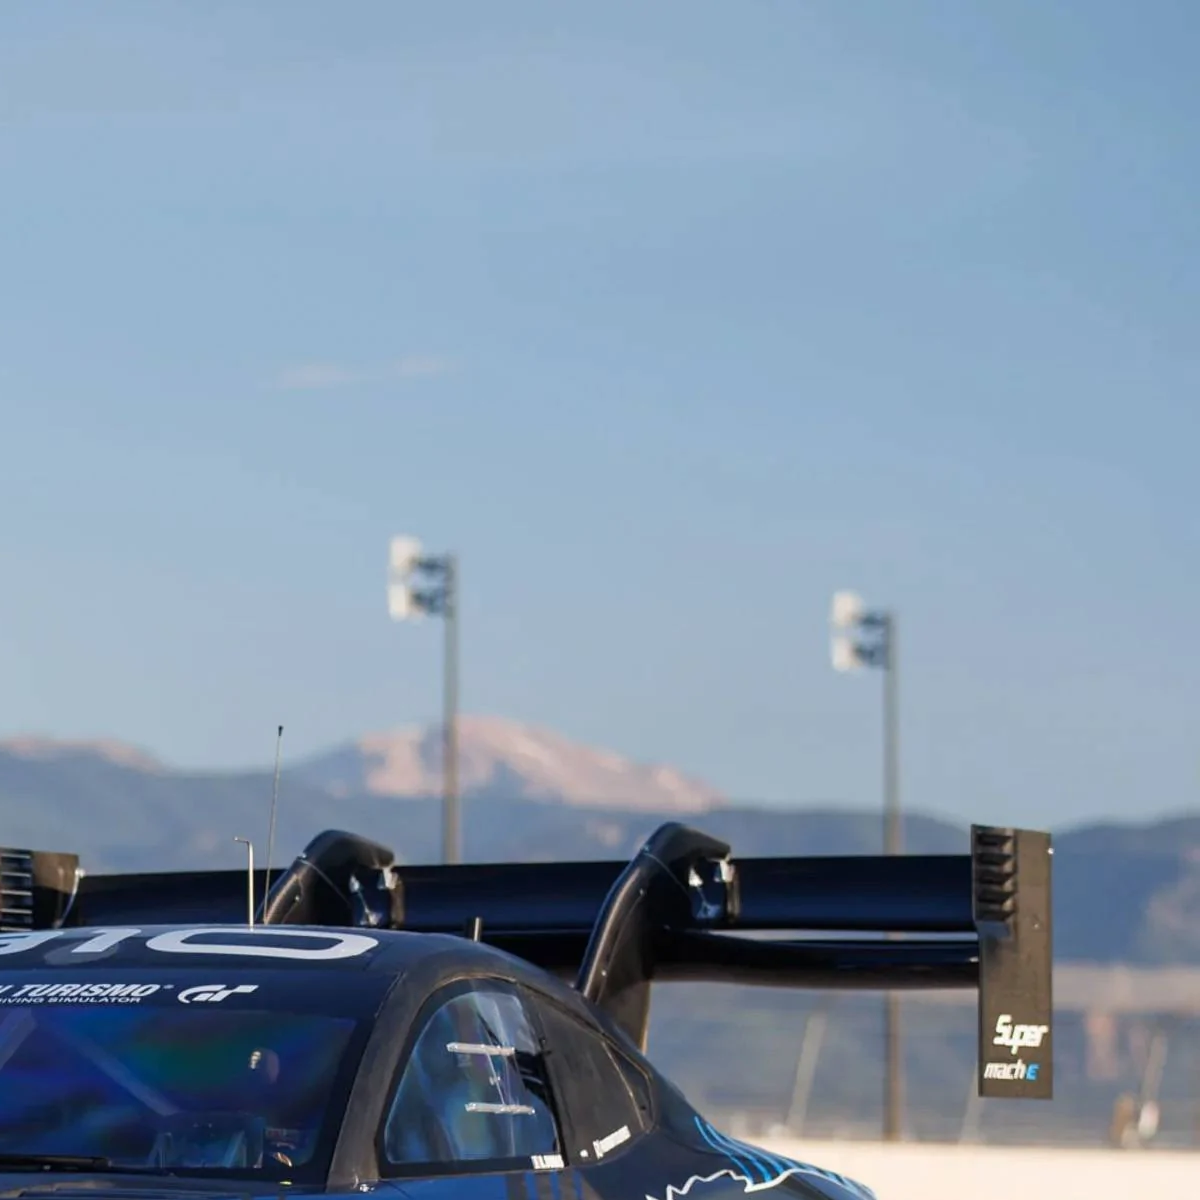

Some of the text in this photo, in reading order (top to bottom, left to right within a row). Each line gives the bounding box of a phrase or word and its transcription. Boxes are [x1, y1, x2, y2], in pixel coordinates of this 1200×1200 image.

[13, 983, 161, 998] TURISMO
[47, 996, 141, 1004] SIMULATOR
[993, 1013, 1049, 1055] Super
